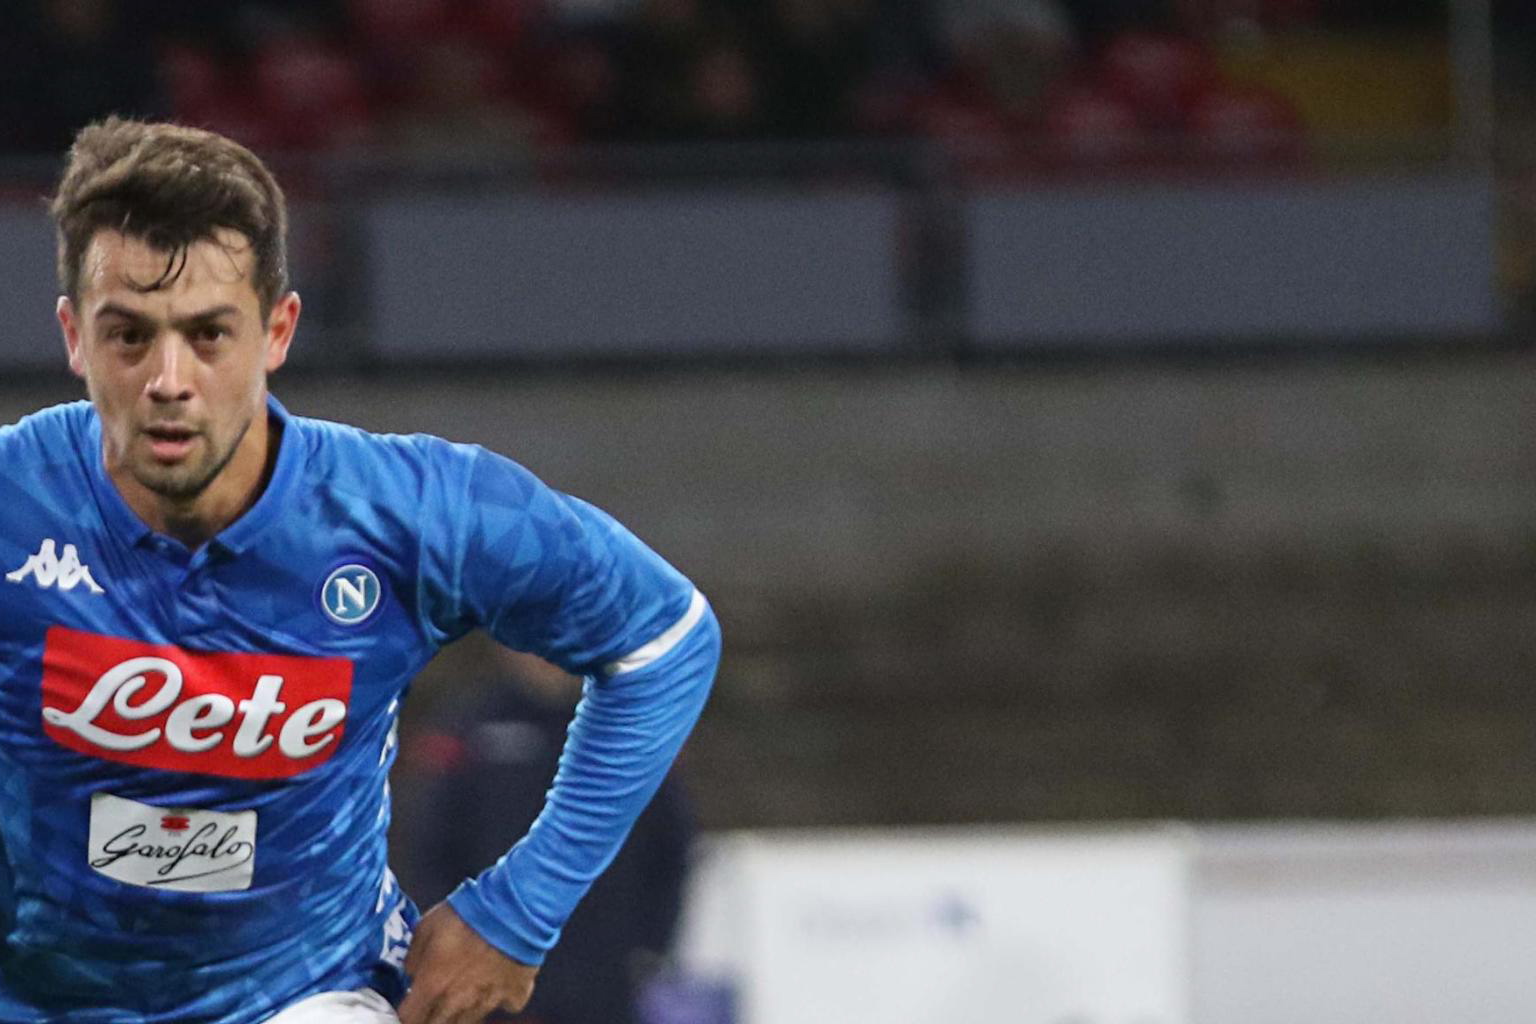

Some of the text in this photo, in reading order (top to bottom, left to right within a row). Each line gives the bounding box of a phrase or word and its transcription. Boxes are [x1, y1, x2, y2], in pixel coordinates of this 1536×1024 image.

[334, 575, 368, 614] N
[42, 656, 347, 758] Lete
[90, 822, 253, 885] Garofalo
